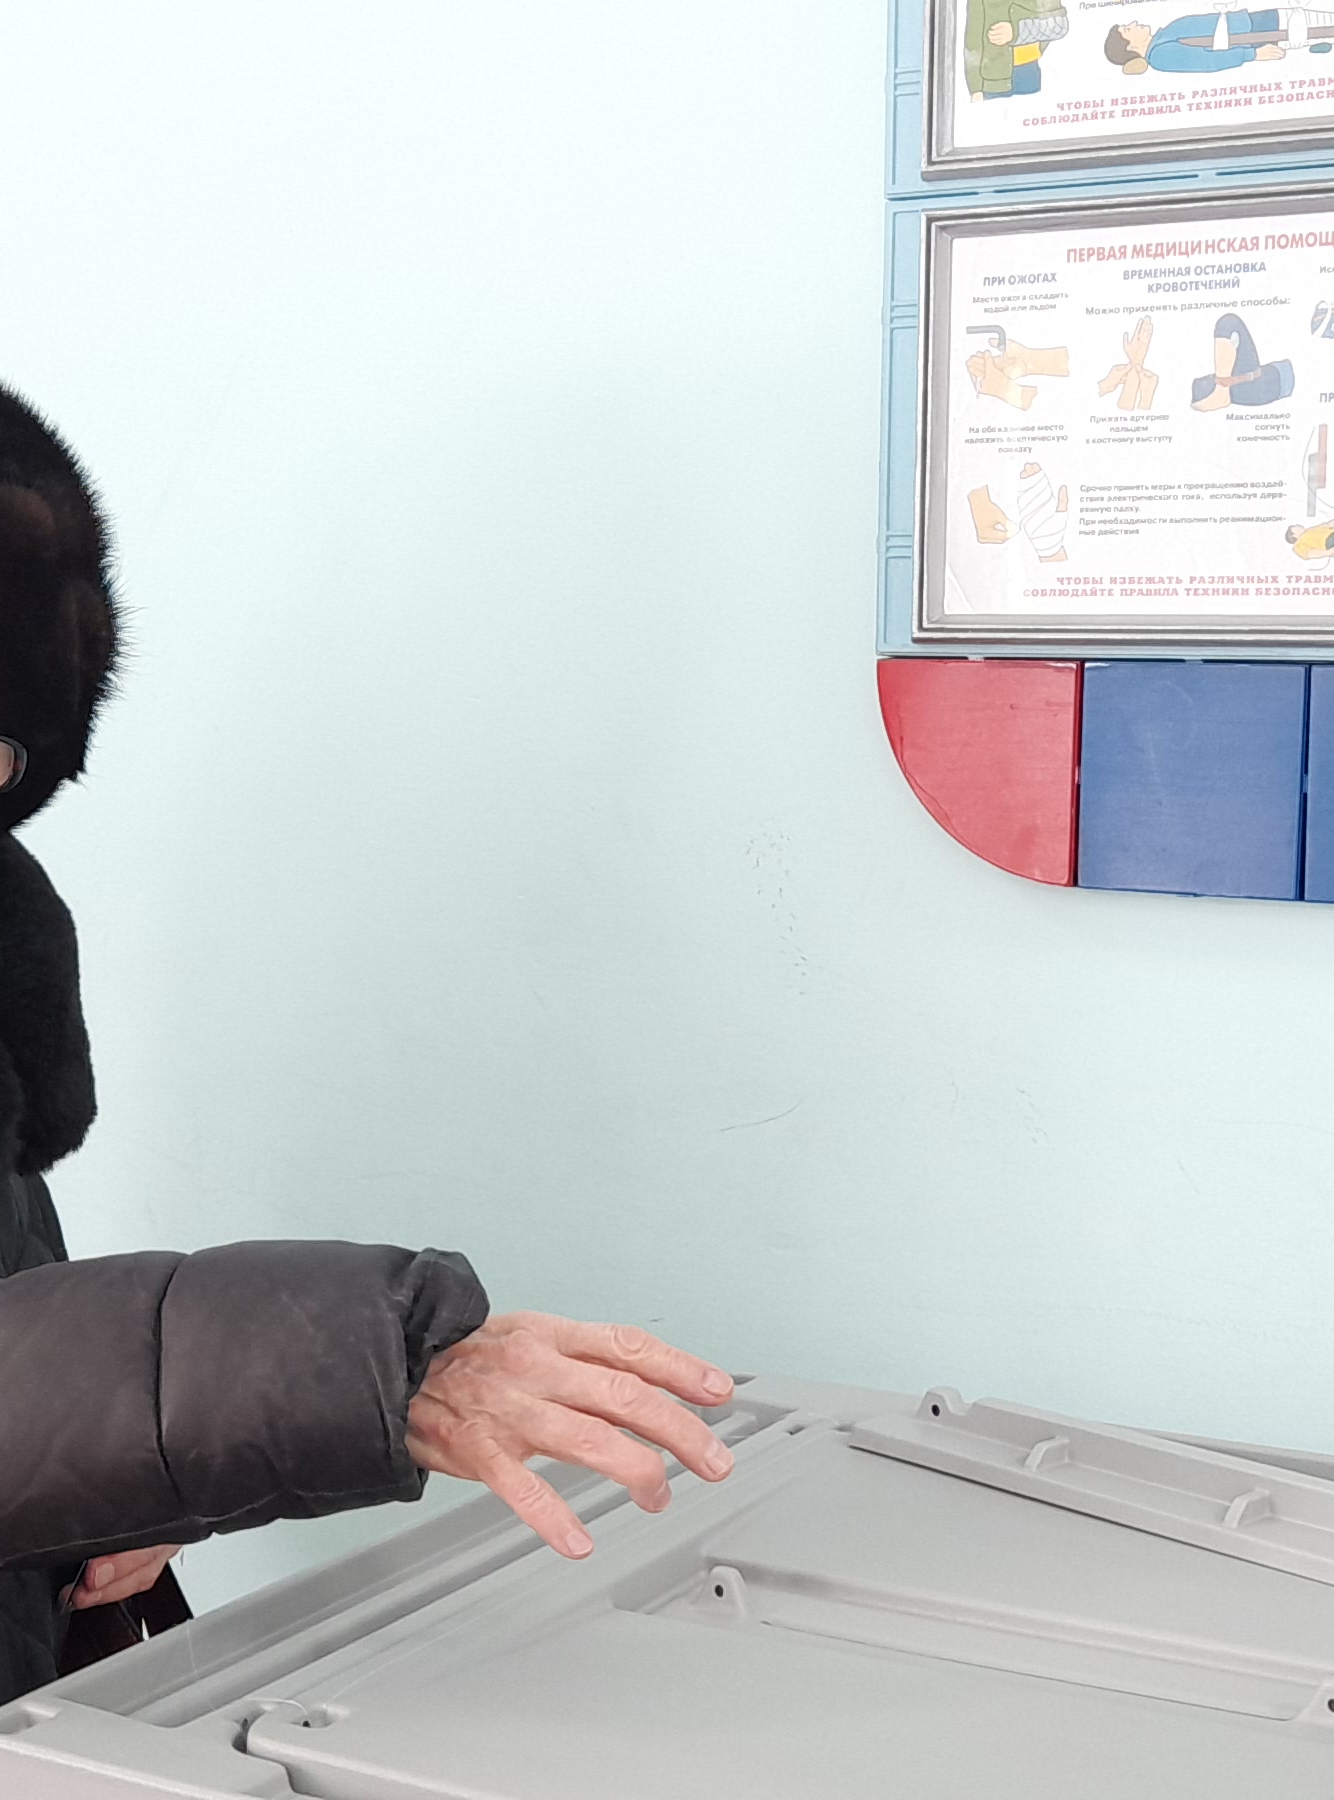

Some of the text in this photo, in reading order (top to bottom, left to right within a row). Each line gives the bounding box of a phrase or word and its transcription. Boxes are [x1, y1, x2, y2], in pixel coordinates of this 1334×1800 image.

[1056, 98, 1104, 111] ЧТОБЫ
[1110, 91, 1185, 106] ИЗБЕЖАТЬ
[1191, 81, 1283, 99] РАЗЛИЧНЫХ
[1022, 109, 1115, 126] СОБЛЮДАЙТЕ
[1121, 104, 1181, 117] ПРАВИЛА
[1186, 96, 1252, 111] ТЕХНИКИ
[1066, 244, 1127, 263] ПЕРВАЯ
[1130, 236, 1259, 259] МЕДИЦИНСКАЯ
[983, 272, 1057, 286] ПРИ ОЖОГАХ
[1122, 261, 1266, 280] ВРЕМЕННАЯ ОСТАНОВКА
[1147, 276, 1240, 293] КРОВОТЕЧЕНИЙ
[1056, 576, 1103, 585] ЧТОБЫ
[1109, 575, 1183, 585] ИЗБЕЖАТЬ
[1188, 574, 1279, 584] РАЗЛИЧНЫХ
[1023, 586, 1114, 597] СОБЛЮДАЙТЕ
[1119, 587, 1179, 596] ПРАВИЛА
[1183, 586, 1249, 596] ТЕХНИКИ
